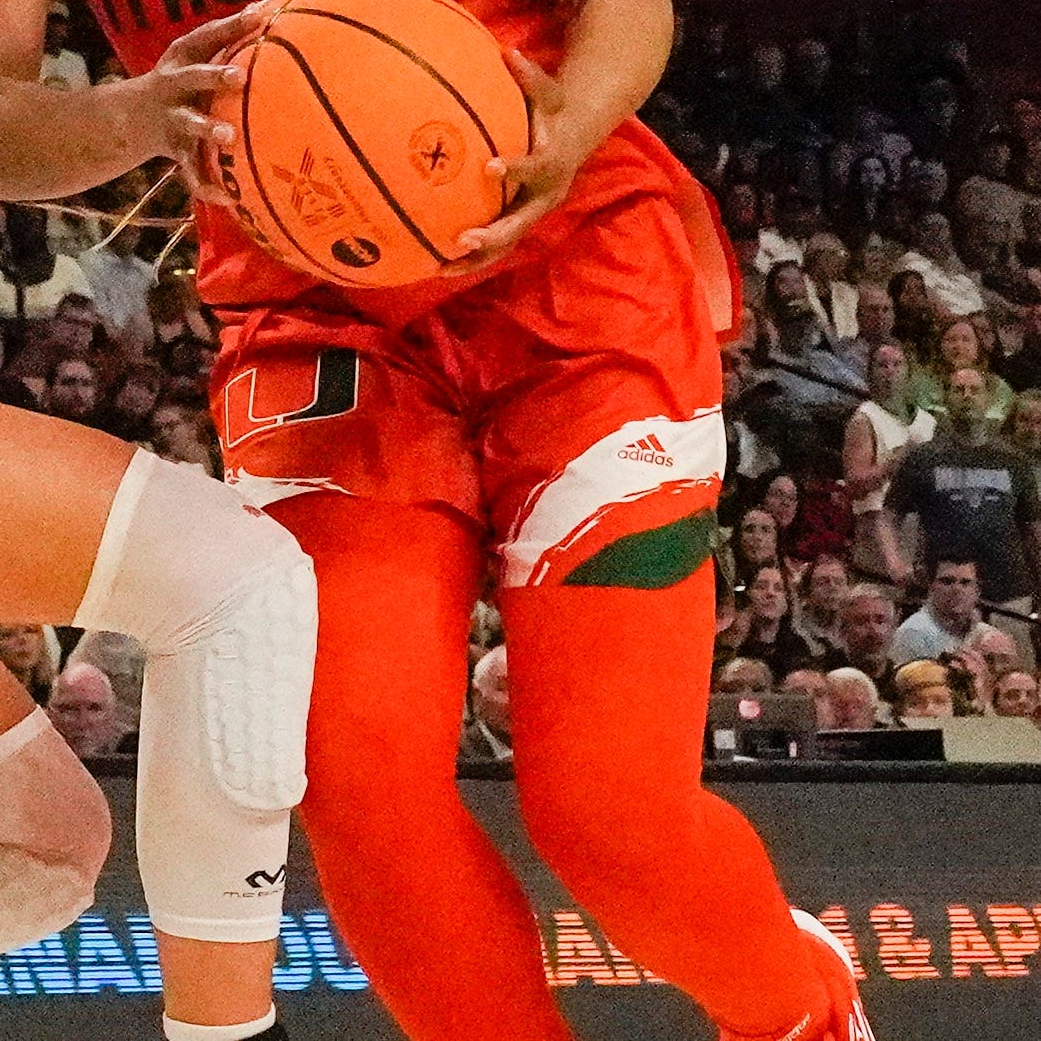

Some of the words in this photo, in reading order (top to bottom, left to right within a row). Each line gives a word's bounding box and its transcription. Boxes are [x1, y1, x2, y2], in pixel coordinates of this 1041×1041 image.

[617, 448, 675, 468] adidas
[869, 902, 941, 981] &
[946, 902, 1041, 979] AP
